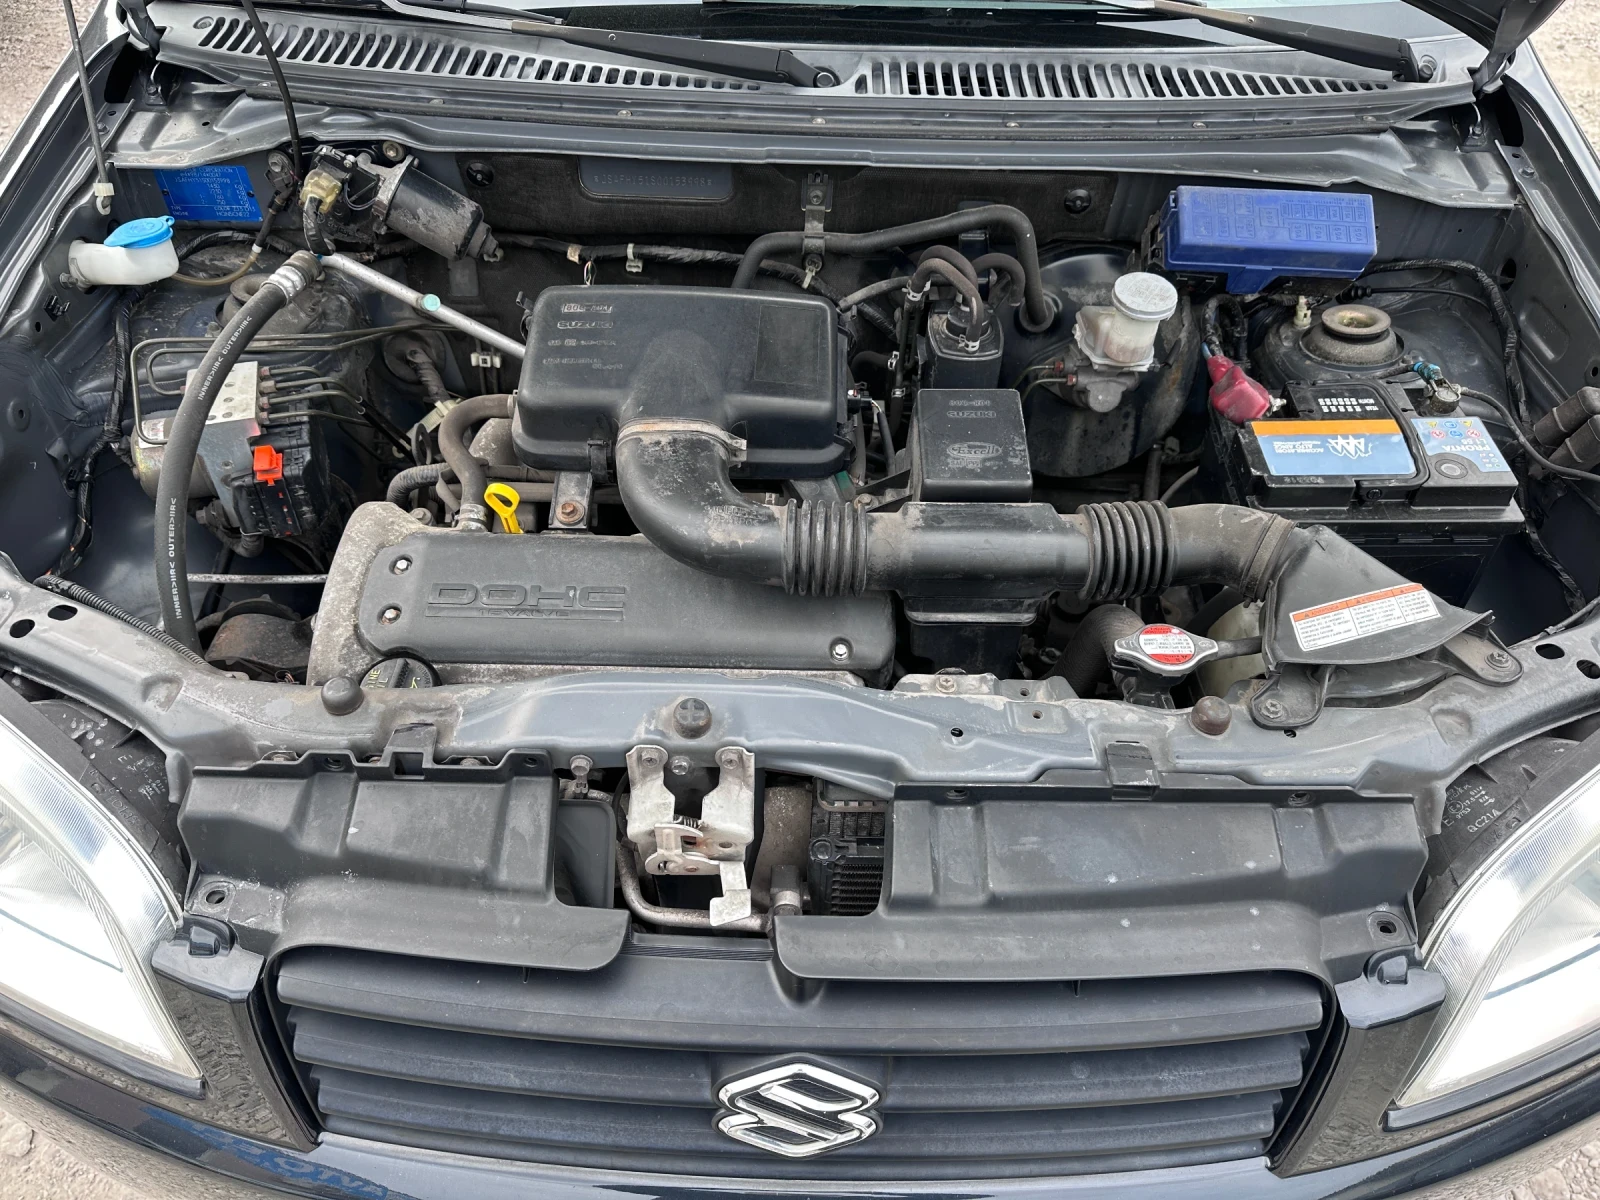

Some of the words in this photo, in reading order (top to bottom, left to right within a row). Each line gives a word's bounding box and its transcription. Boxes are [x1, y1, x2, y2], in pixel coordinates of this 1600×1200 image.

[557, 320, 614, 329] SUZUKI
[947, 410, 996, 418] SUZUKI
[427, 582, 626, 609] DOHC
